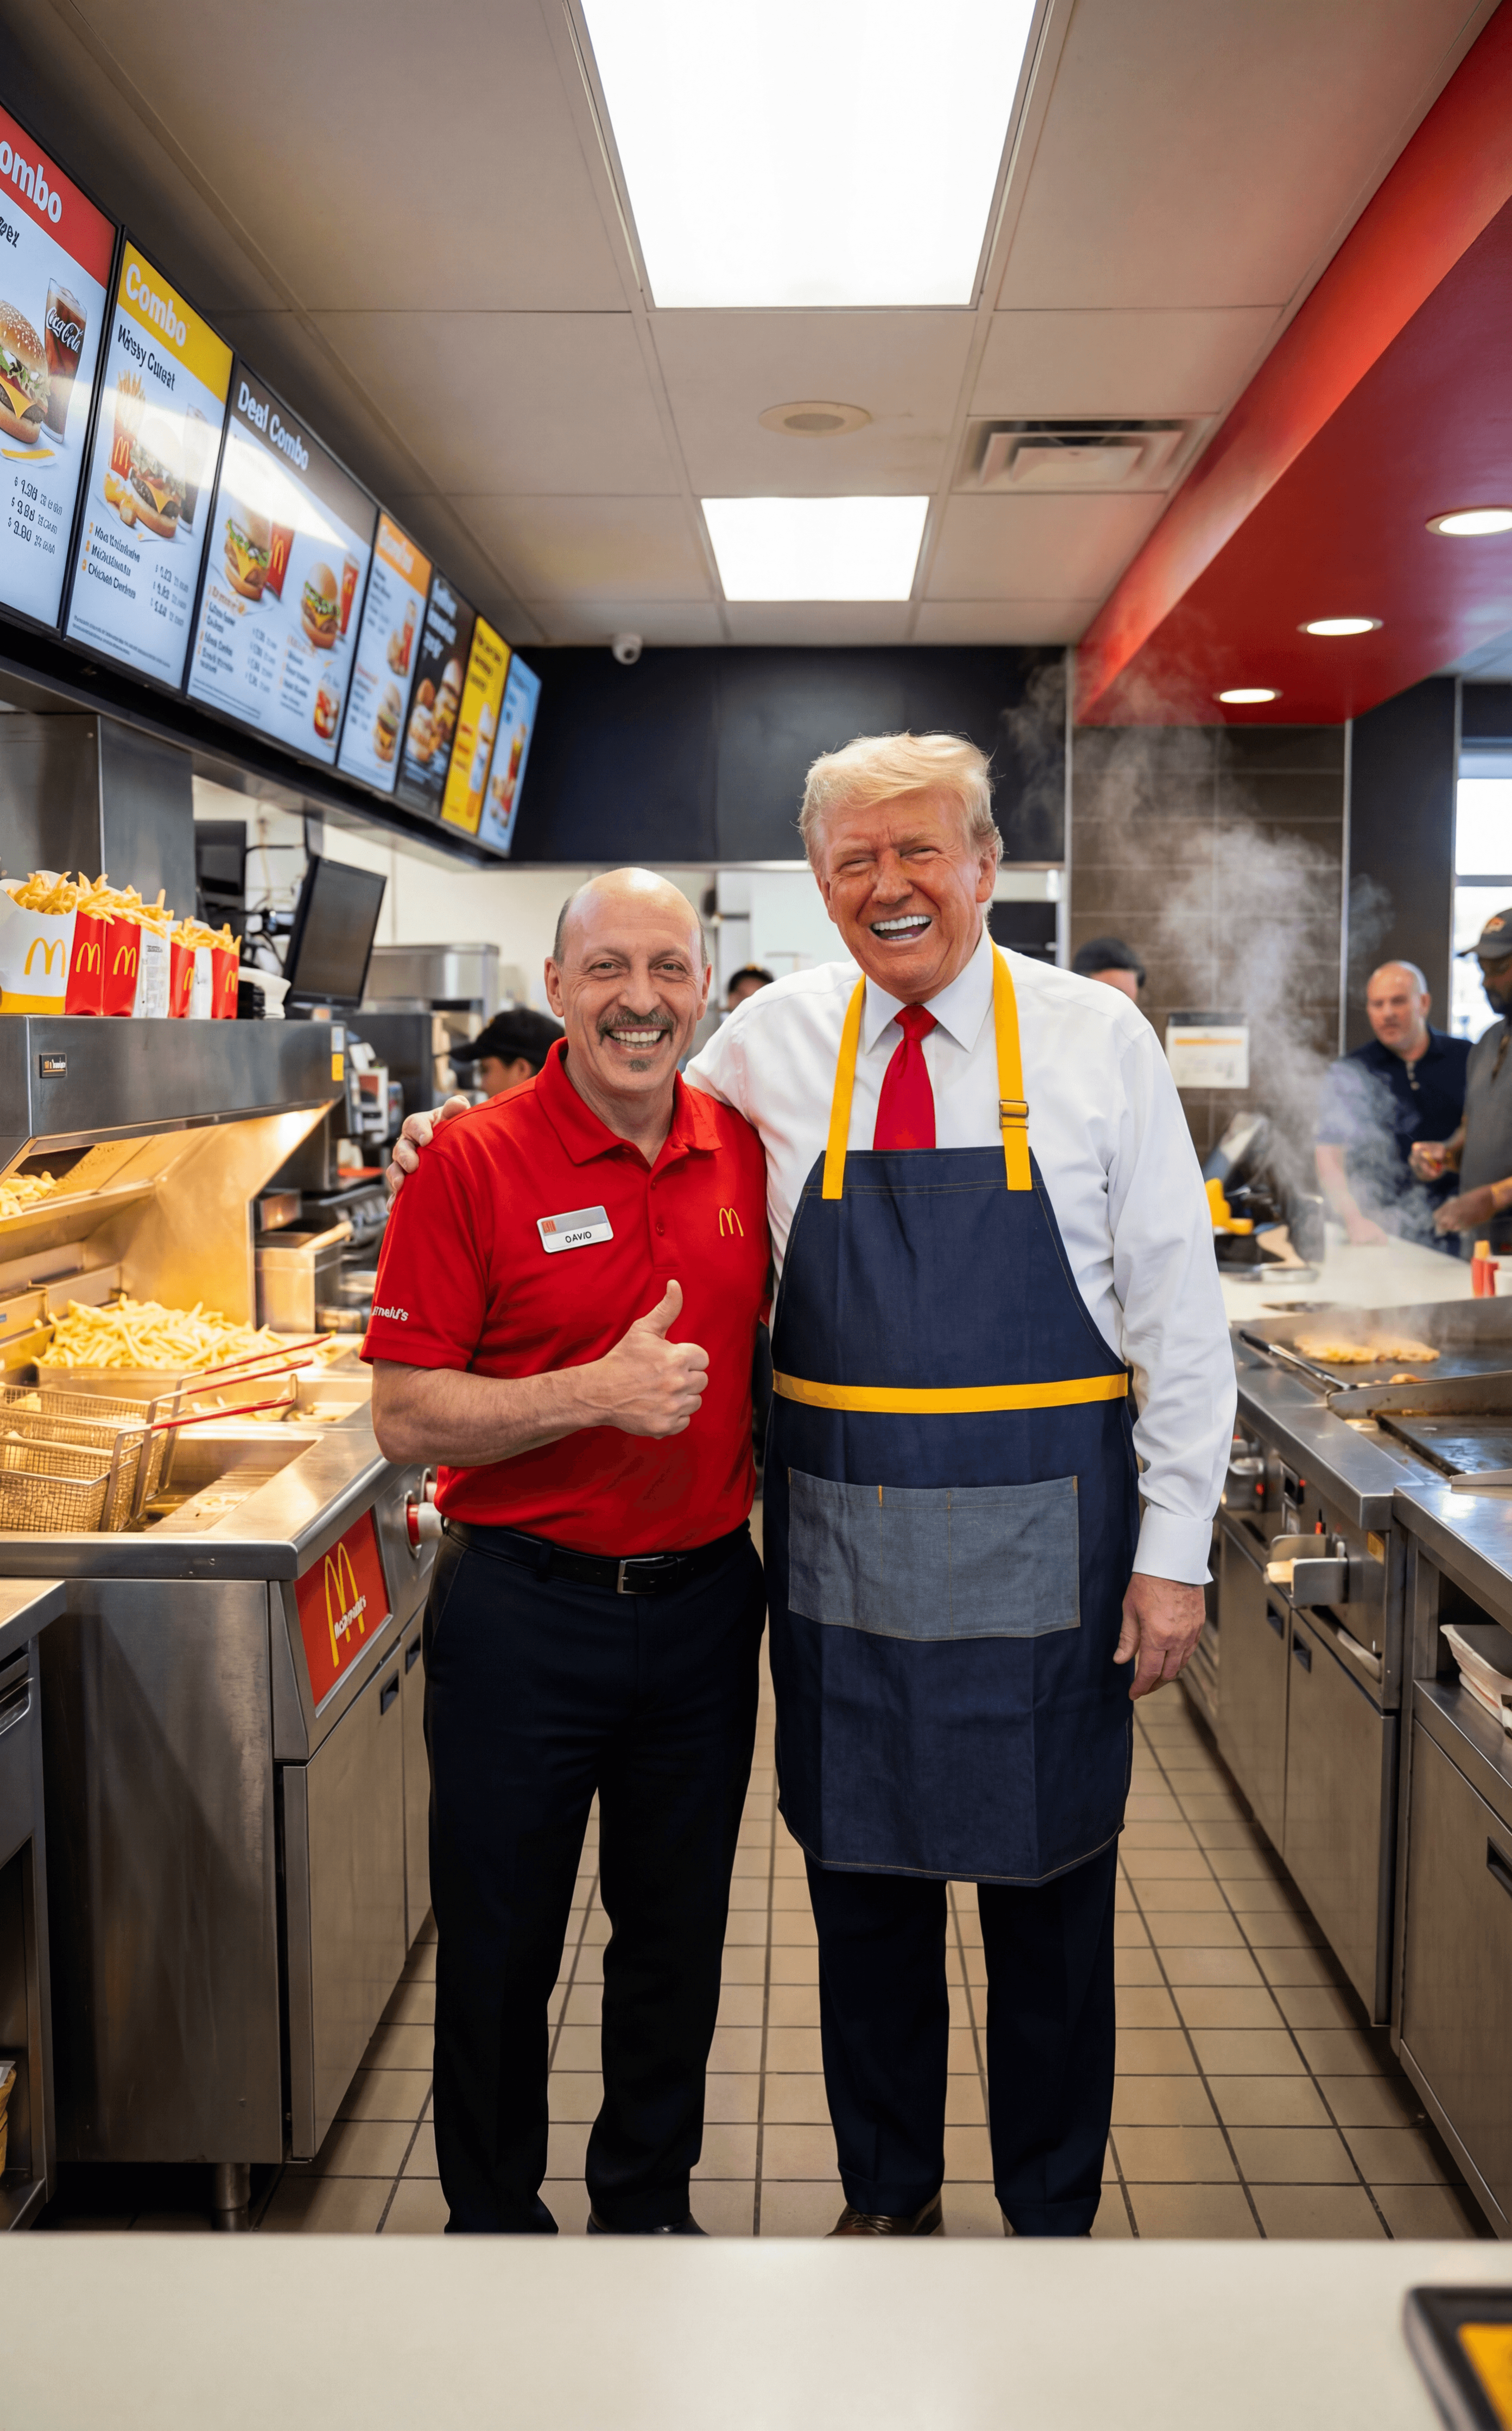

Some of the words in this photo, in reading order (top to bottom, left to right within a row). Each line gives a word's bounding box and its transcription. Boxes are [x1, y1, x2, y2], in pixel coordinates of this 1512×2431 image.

[126, 263, 187, 347] Combo
[238, 381, 270, 433] Deal
[269, 414, 309, 471] Combo
